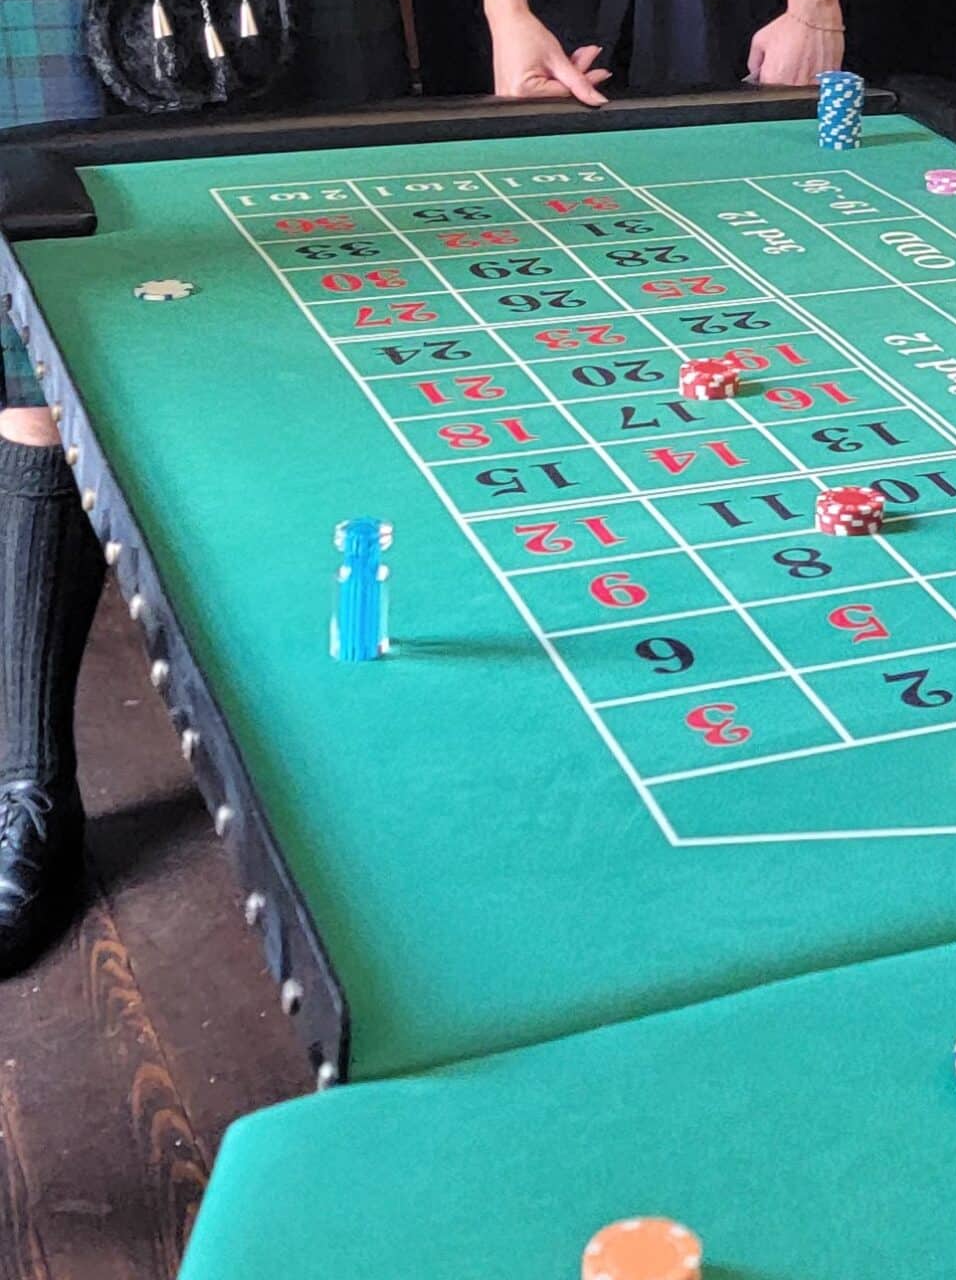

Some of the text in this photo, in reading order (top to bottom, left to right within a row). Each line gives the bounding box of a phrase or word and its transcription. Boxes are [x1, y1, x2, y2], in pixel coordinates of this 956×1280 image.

[374, 179, 479, 197] 2 to 1
[502, 171, 604, 188] 2 to 1
[236, 189, 348, 207] 2 to 1
[541, 195, 621, 214] 34
[275, 213, 358, 234] 36
[413, 205, 492, 224] 35
[580, 219, 654, 238] 31
[437, 228, 521, 249] 32
[717, 210, 806, 255] 3rd 12
[295, 240, 381, 260] 33
[605, 245, 689, 268] 28
[879, 230, 956, 269] ODD
[320, 268, 407, 293] 30
[469, 256, 553, 280] 29
[497, 288, 587, 313] 26
[641, 274, 727, 300] 25
[354, 301, 438, 328] 27
[679, 310, 772, 335] 22
[534, 324, 626, 351] 23
[883, 332, 945, 357] 12
[371, 340, 472, 366] 24
[724, 342, 812, 372] 19
[572, 359, 665, 388] 20
[408, 374, 506, 406] 21
[763, 381, 858, 411] 16
[620, 400, 705, 430] 17
[437, 418, 541, 450] 18
[811, 421, 909, 453] 13
[641, 440, 750, 475] 14
[475, 461, 580, 498] 15
[699, 493, 805, 528] 11
[513, 516, 628, 556] 12
[772, 547, 833, 580] 8
[589, 571, 649, 608] 9
[826, 604, 891, 644] 5
[634, 636, 695, 674] 6
[882, 667, 953, 709] 2
[684, 702, 752, 748] 3
